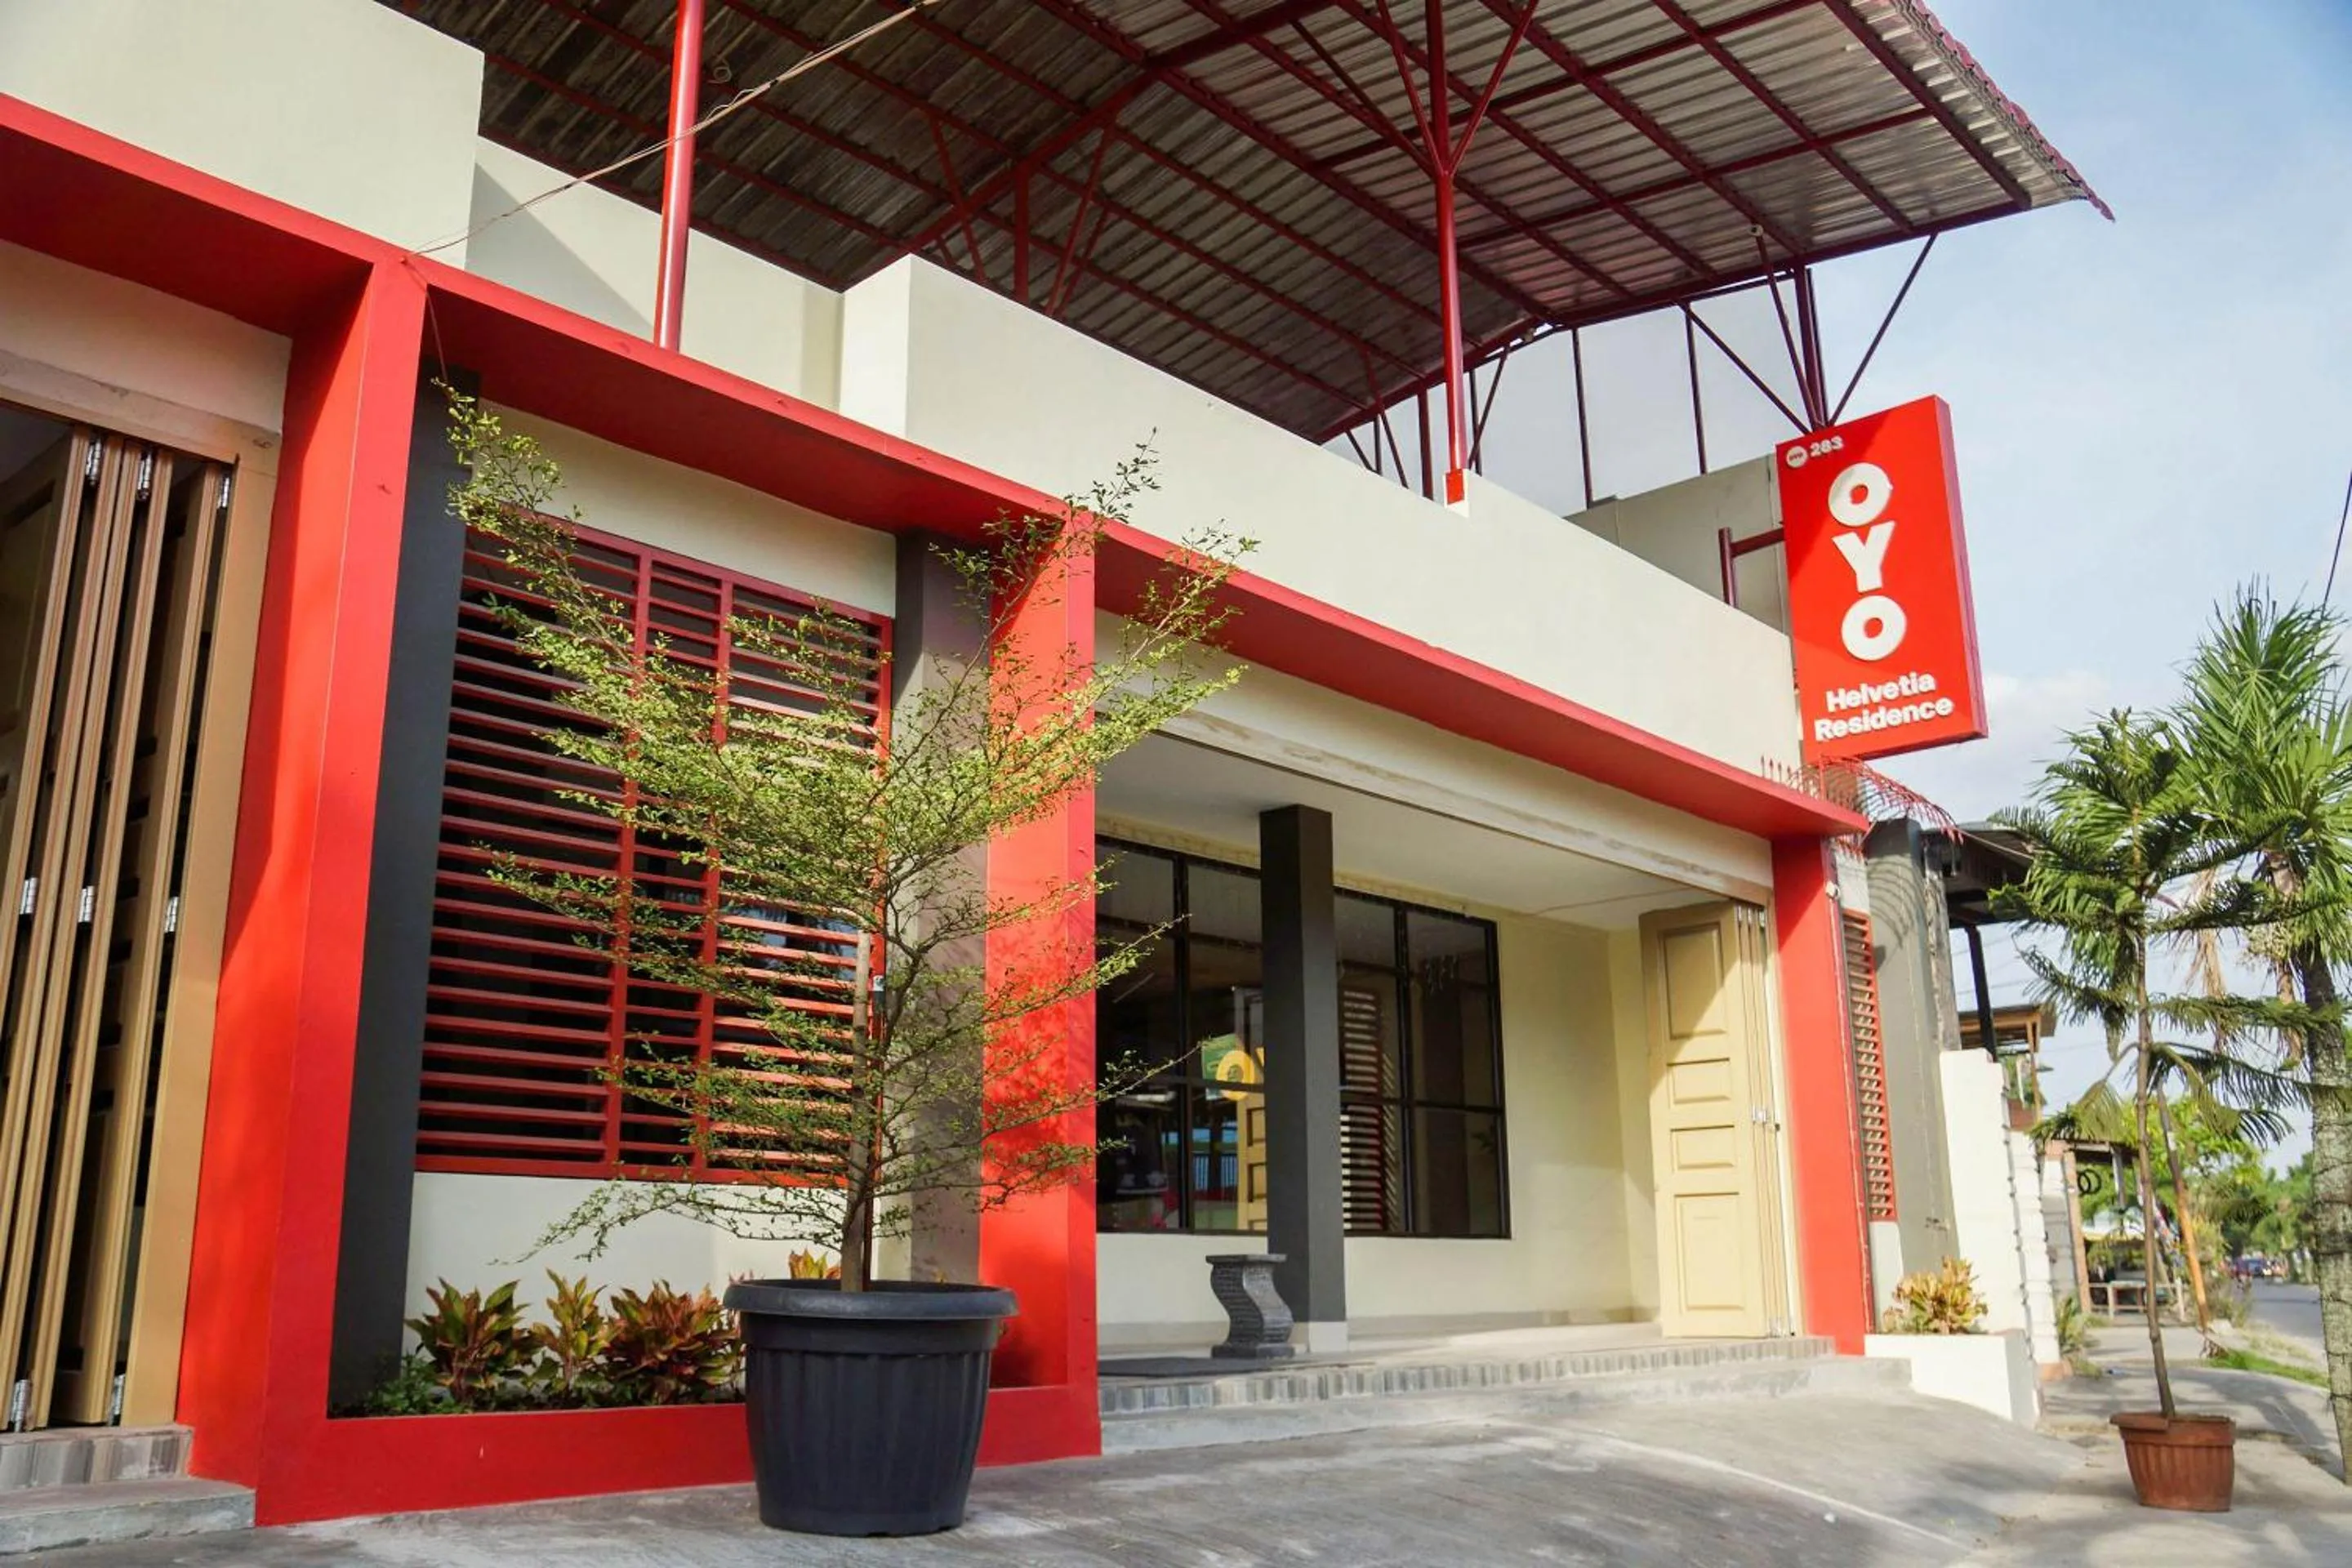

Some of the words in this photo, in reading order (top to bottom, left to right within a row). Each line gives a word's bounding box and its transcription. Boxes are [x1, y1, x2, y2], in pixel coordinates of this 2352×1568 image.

[1828, 462, 1908, 661] OYO
[1825, 671, 1936, 713] Helvetia
[1814, 697, 1954, 742] Residence
